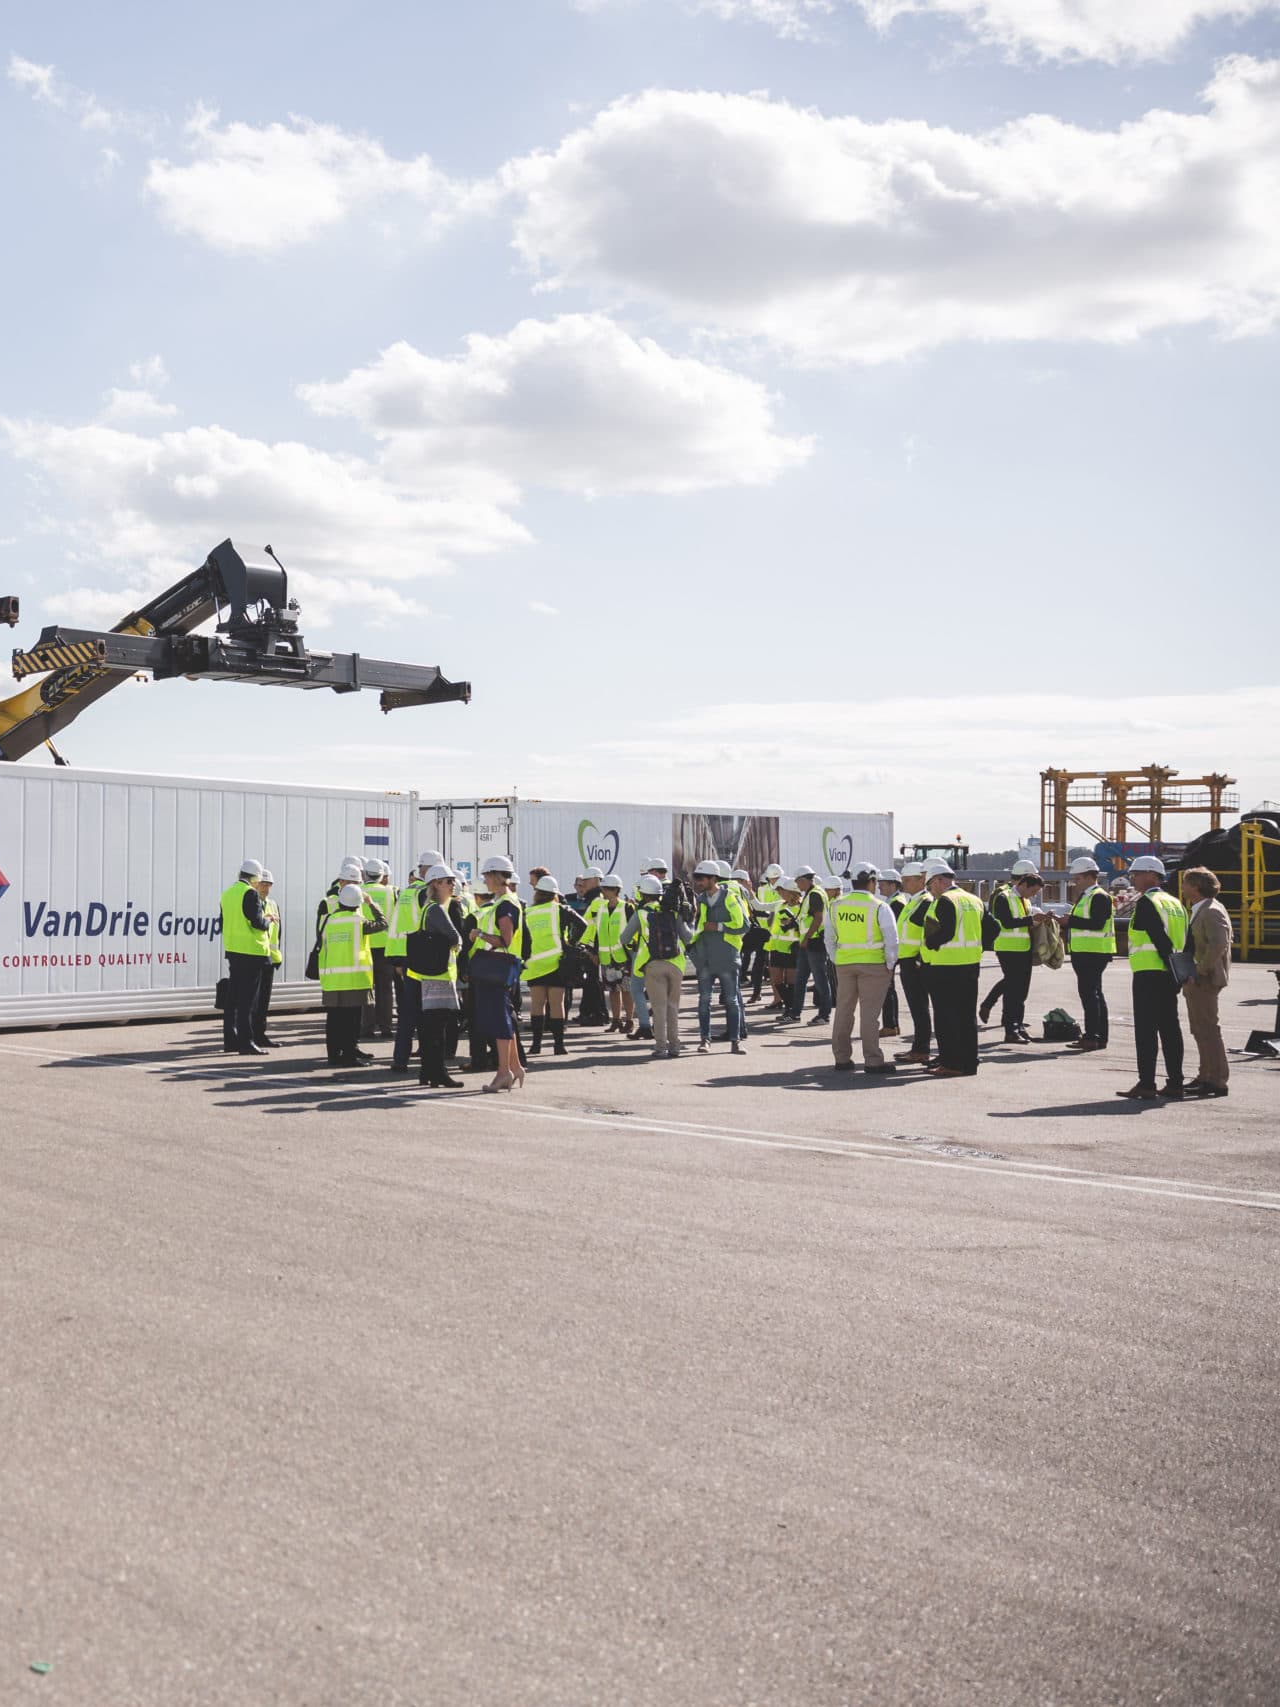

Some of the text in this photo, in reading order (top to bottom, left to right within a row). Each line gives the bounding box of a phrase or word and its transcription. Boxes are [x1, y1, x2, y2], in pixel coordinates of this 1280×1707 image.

[586, 844, 612, 861] Vion
[829, 847, 847, 861] Vion
[23, 902, 222, 941] VanDrie Group
[838, 912, 865, 923] VION
[2, 952, 188, 968] CONTROLLED QUALITY VEAL
